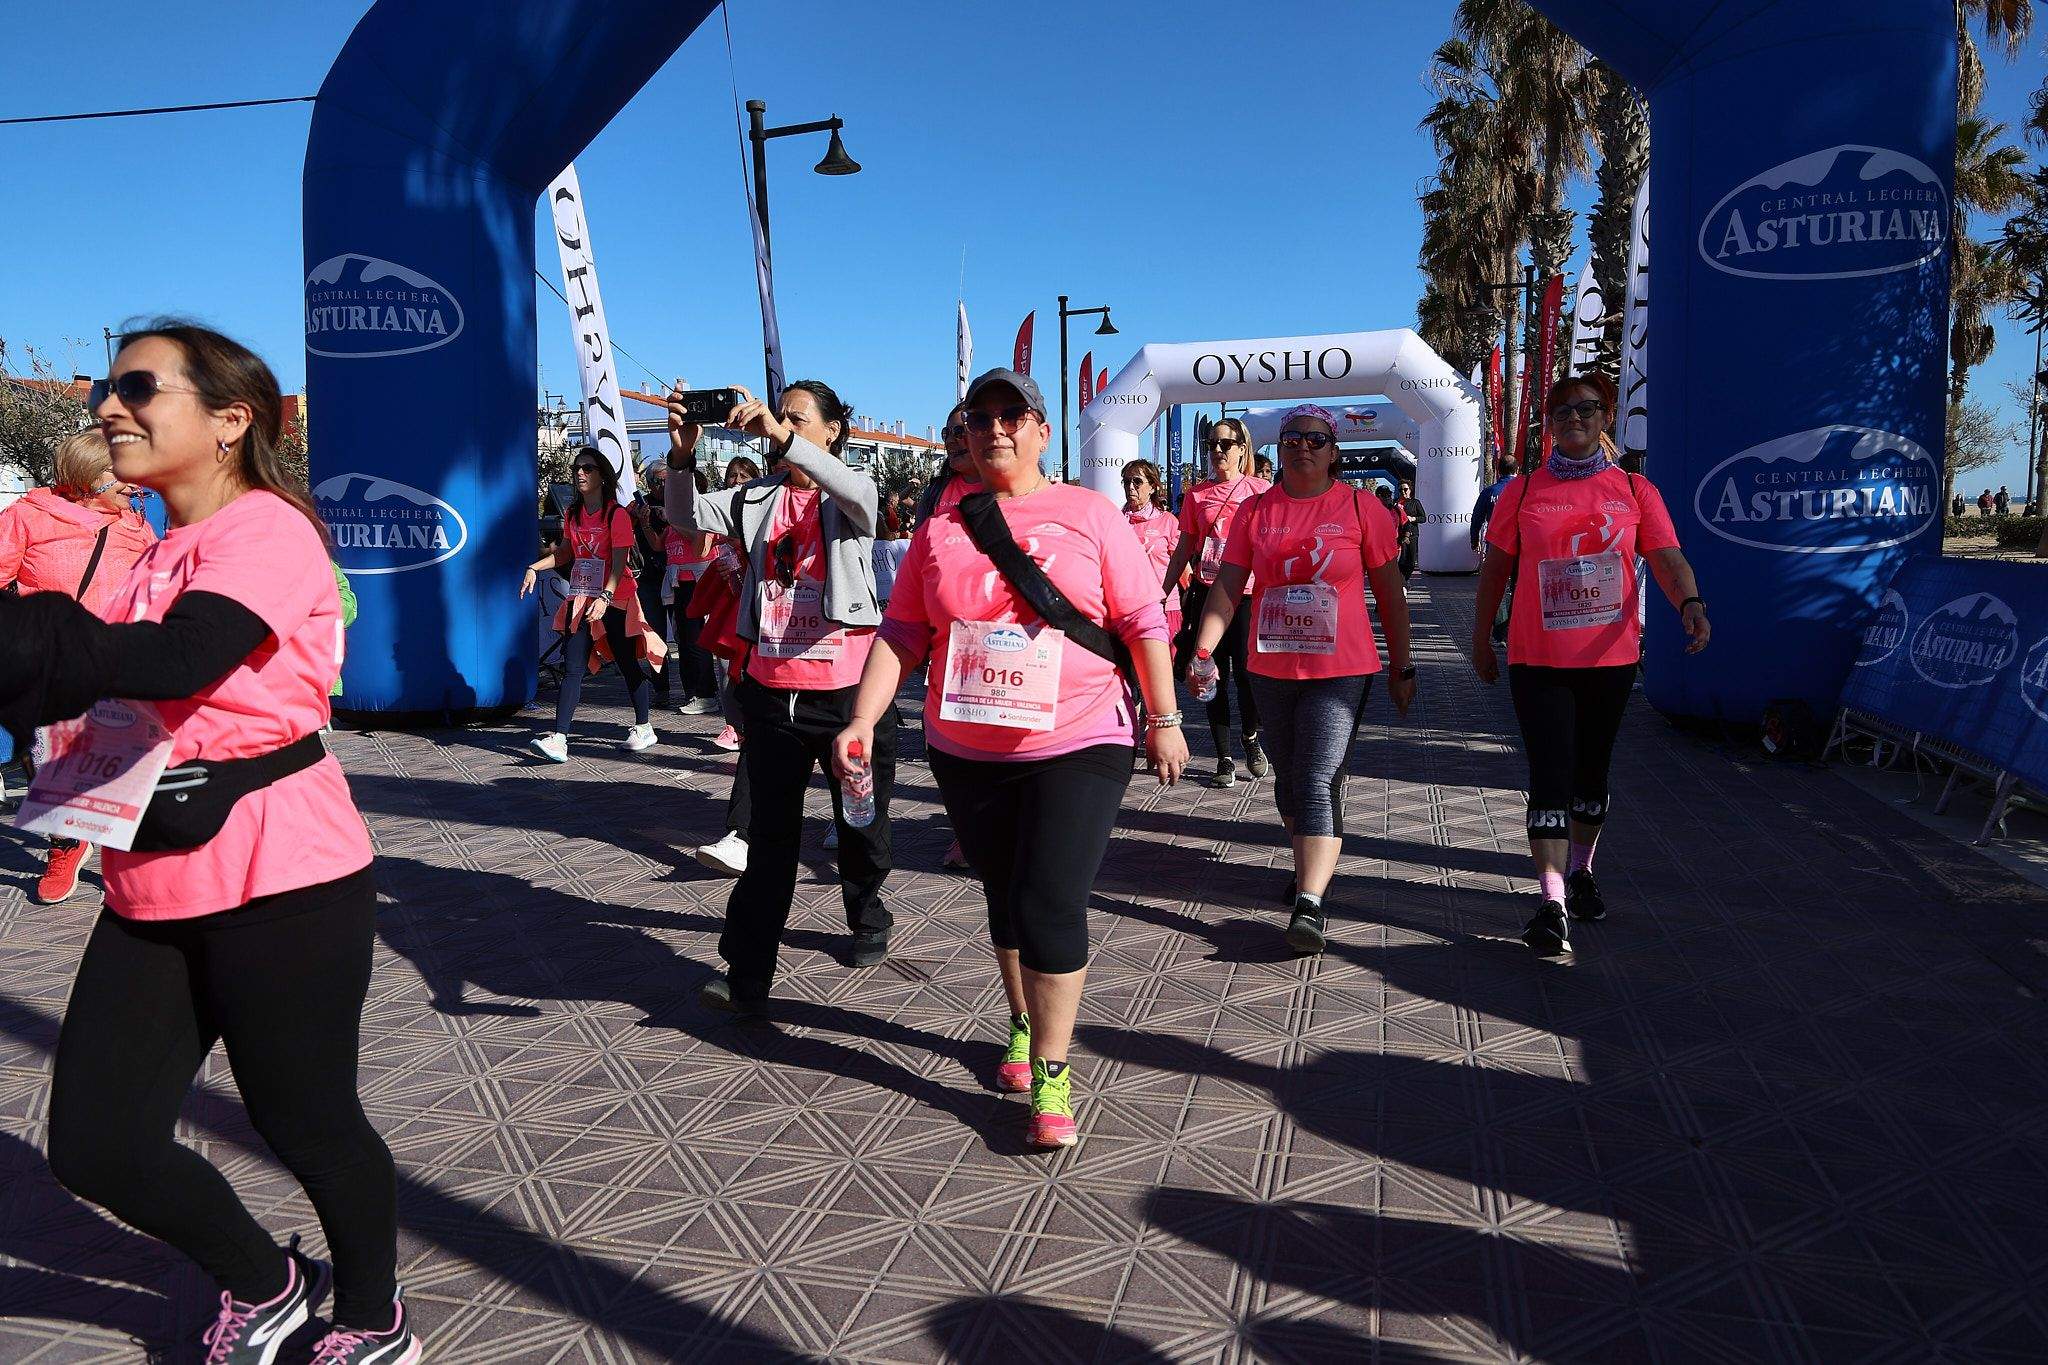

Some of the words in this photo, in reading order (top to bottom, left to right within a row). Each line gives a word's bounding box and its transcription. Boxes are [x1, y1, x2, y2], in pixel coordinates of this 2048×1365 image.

[1761, 191, 1857, 212] CENTRAL
[1868, 189, 1938, 202] LECHERA
[1716, 208, 1940, 258] ASTURIANA
[312, 290, 360, 302] CENTRAL
[367, 290, 439, 303] LECHERA
[1192, 348, 1352, 385] OYSHO
[1400, 378, 1451, 391] OYSHO
[1103, 394, 1148, 405] OYSHO
[1428, 446, 1475, 458] OYSHO
[1083, 457, 1125, 468] OYSHO
[1341, 455, 1379, 463] LVO
[1755, 469, 1849, 484] CENTRAL
[1859, 466, 1928, 480] LECHERA
[1711, 476, 1931, 523] ASTURIANA
[371, 508, 442, 520] LECHERA
[1427, 513, 1473, 525] OYSHO
[325, 522, 451, 550] TURIANA
[1570, 587, 1600, 600] 016
[788, 616, 820, 628] 016
[1284, 615, 1313, 627] 016
[985, 637, 1024, 649] ASTURIANA
[809, 647, 836, 655] Santander
[982, 667, 1024, 687] 016
[991, 689, 1006, 697] 980
[953, 707, 987, 717] OYSHO
[1007, 712, 1042, 723] Santander
[78, 752, 123, 778] 016
